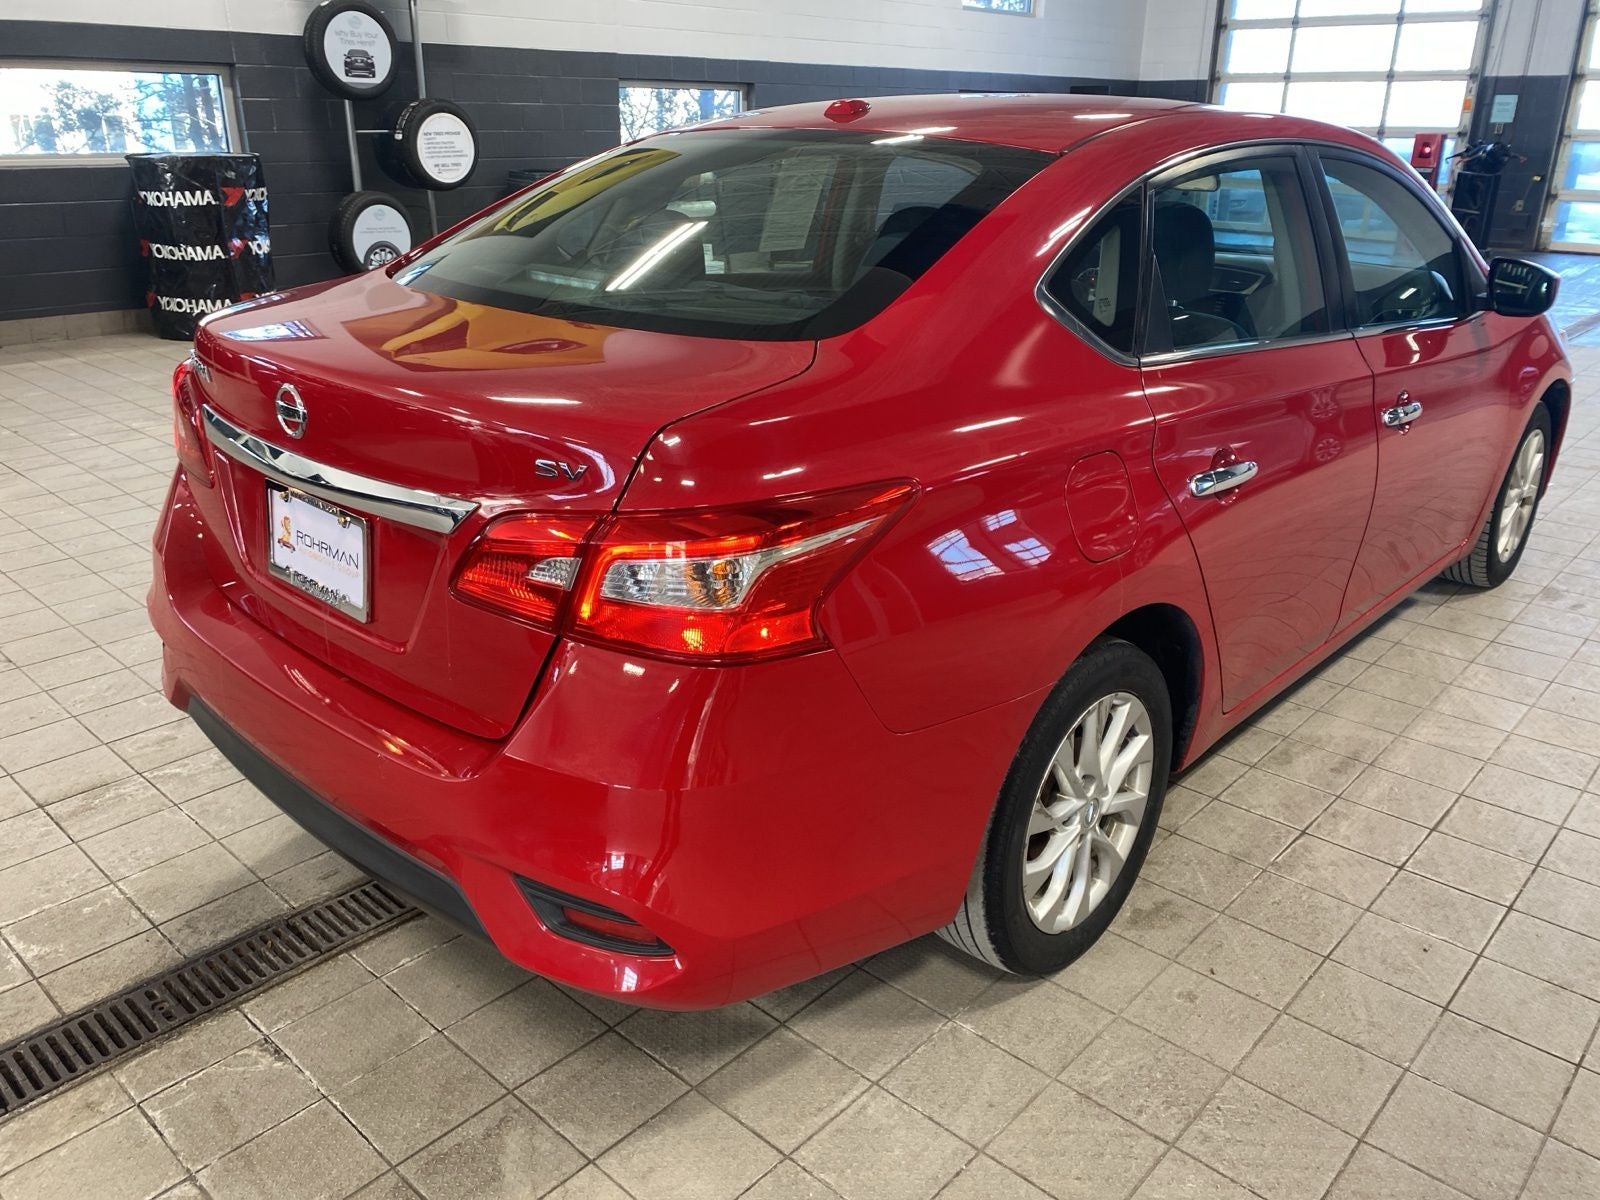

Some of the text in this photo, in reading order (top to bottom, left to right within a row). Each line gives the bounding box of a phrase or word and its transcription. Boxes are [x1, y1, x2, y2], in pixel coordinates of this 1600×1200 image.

[149, 243, 226, 262] YOKOHAMA
[535, 458, 588, 481] SV
[296, 529, 360, 570] ROHRMAN
